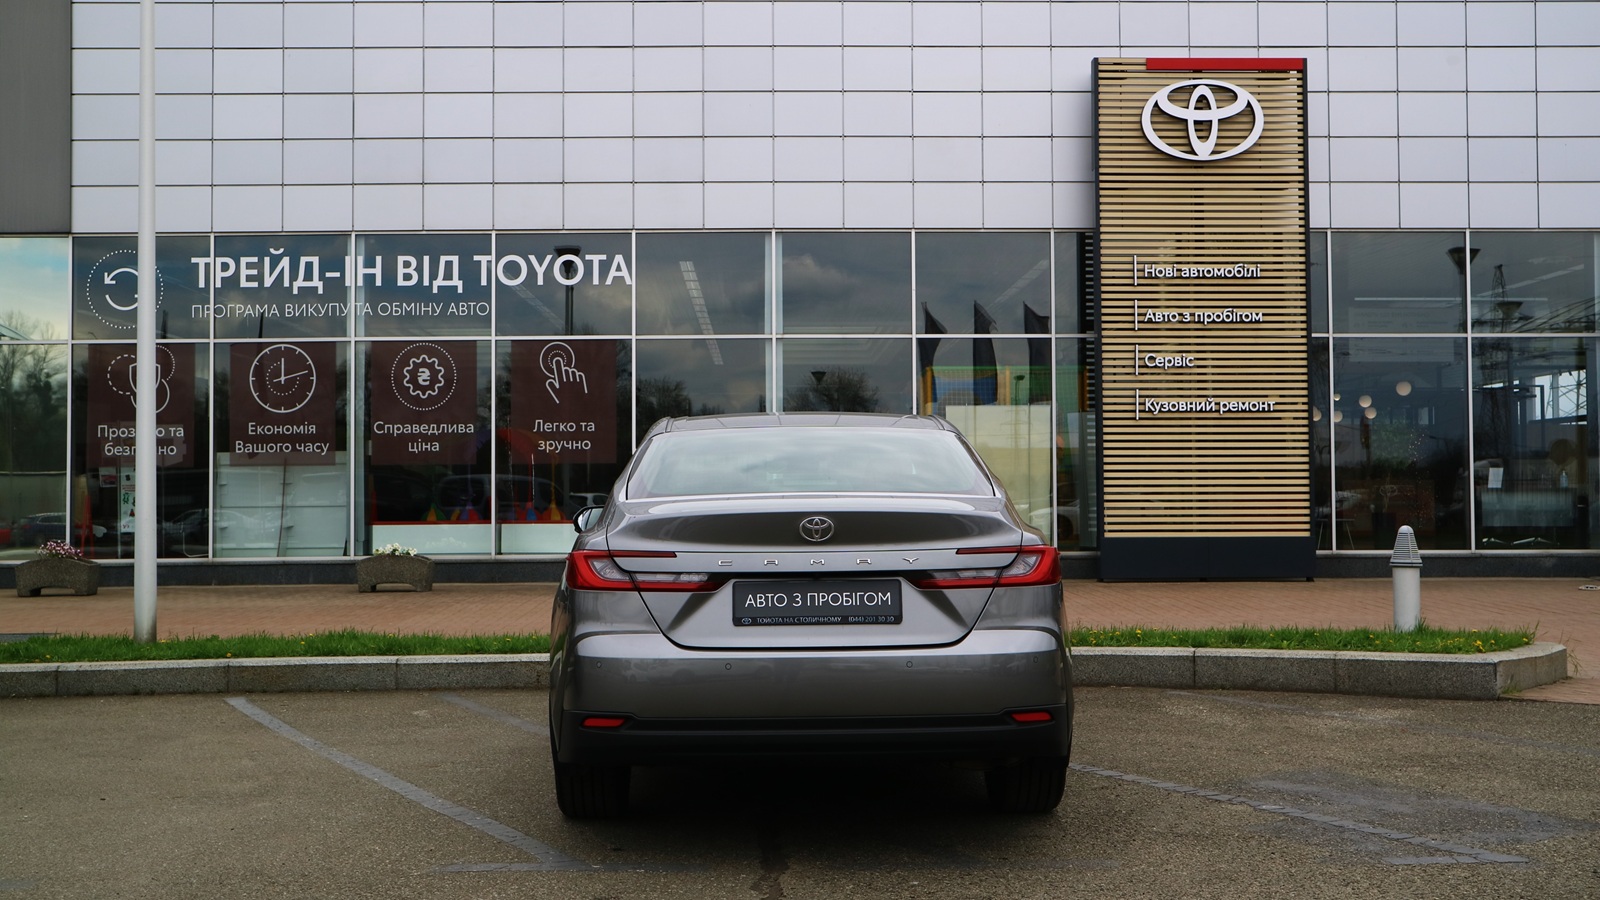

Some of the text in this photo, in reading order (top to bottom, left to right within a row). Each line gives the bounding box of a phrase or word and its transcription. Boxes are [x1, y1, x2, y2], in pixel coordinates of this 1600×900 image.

[190, 248, 632, 294] ТРЕЙД-ІН ВІД TOYOTA
[1144, 263, 1261, 278] Нові автомобілі
[191, 302, 490, 318] ПРОГРАМА ВИКУПУ ТА ОБМІНУ АВТО
[1144, 308, 1263, 326] Авто з пробігом
[1144, 353, 1195, 370] Сервіс
[1144, 398, 1276, 415] Кузовний ремонт
[97, 424, 184, 440] Прозо та
[248, 422, 316, 436] Економія
[374, 421, 474, 436] Справедлива
[533, 419, 596, 432] Легко та
[235, 440, 330, 455] Вашого часу
[408, 439, 440, 454] ціна
[538, 438, 592, 454] зручно
[718, 557, 919, 566] CAMRY
[744, 593, 788, 608] АВТО
[806, 592, 892, 606] ПРОБІГОМ
